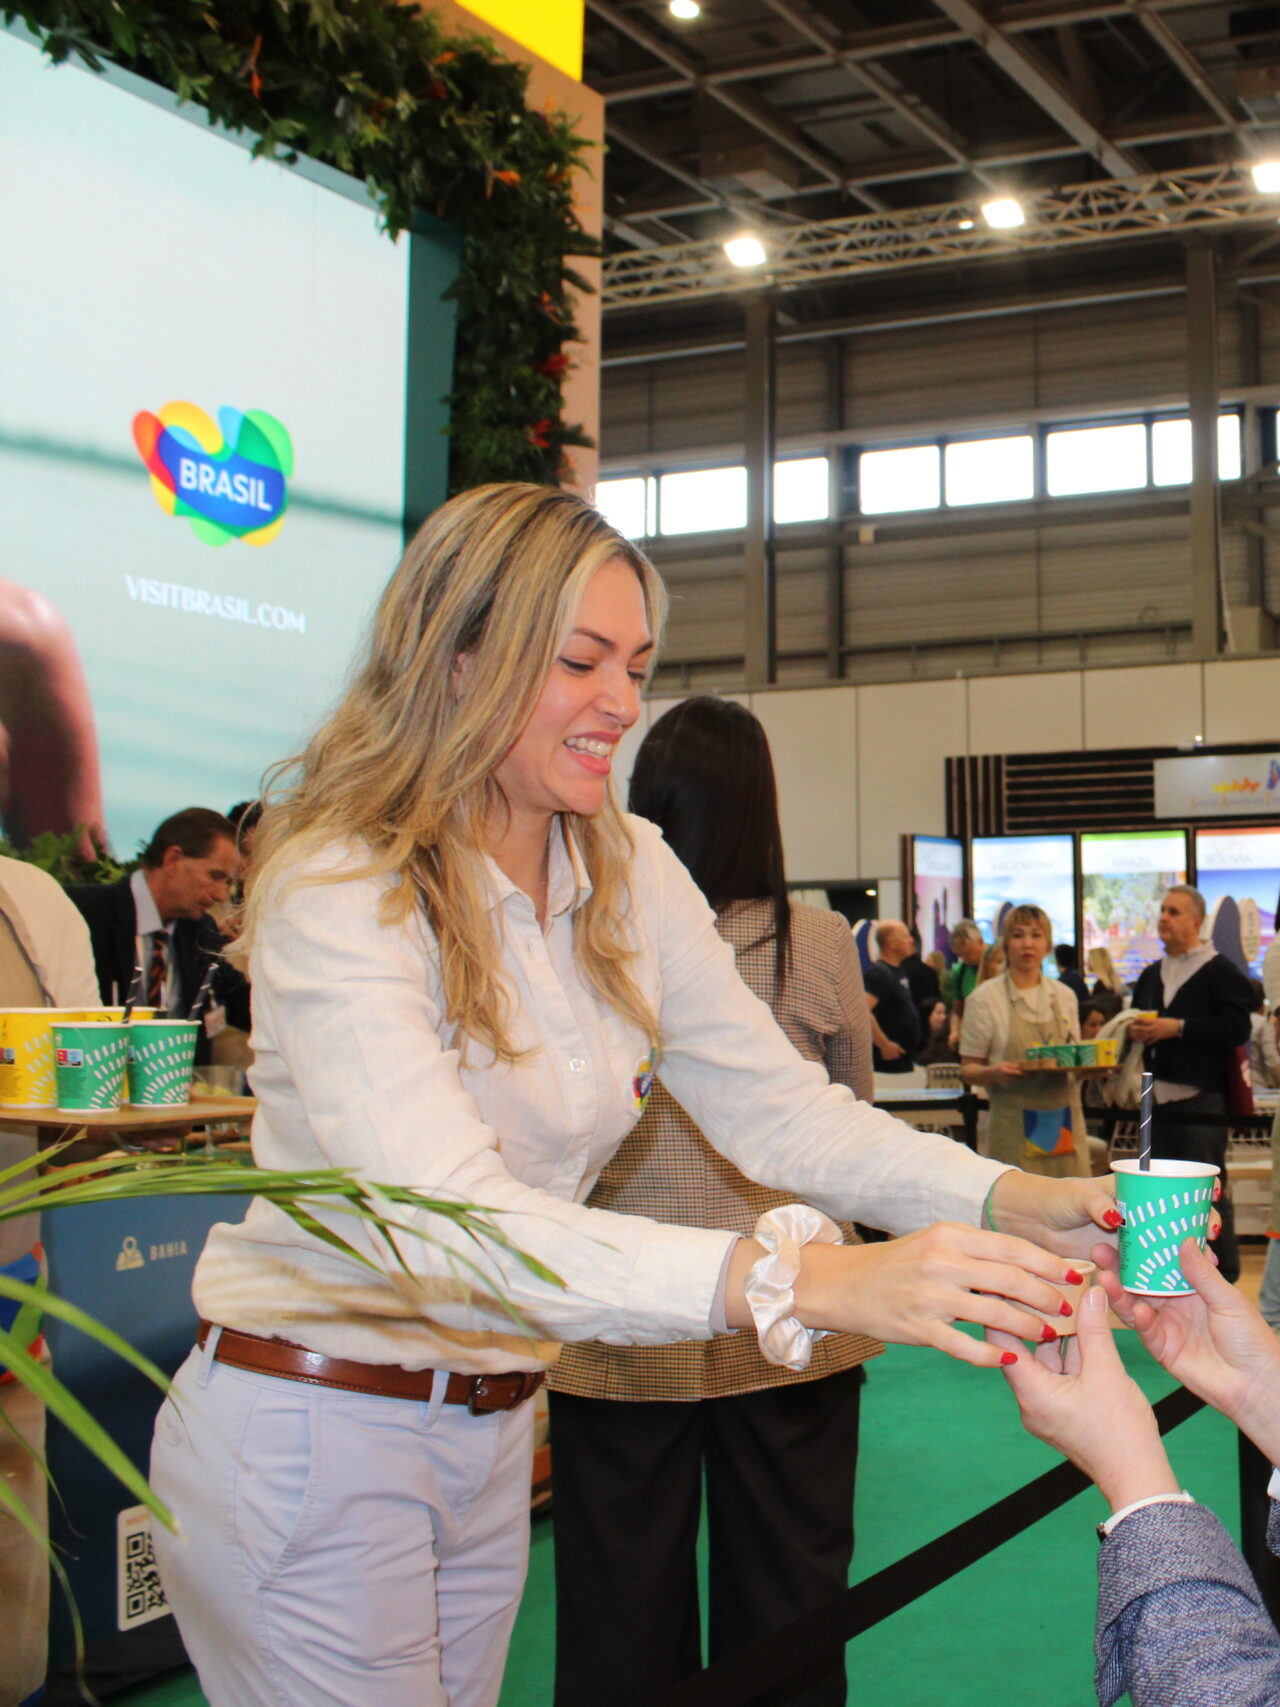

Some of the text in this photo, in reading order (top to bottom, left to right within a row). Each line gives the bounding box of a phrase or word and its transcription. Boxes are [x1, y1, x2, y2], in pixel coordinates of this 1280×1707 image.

[180, 457, 273, 512] BRASIL
[125, 574, 306, 634] VISITBRASIL.COM
[150, 1240, 188, 1260] BAHIA
